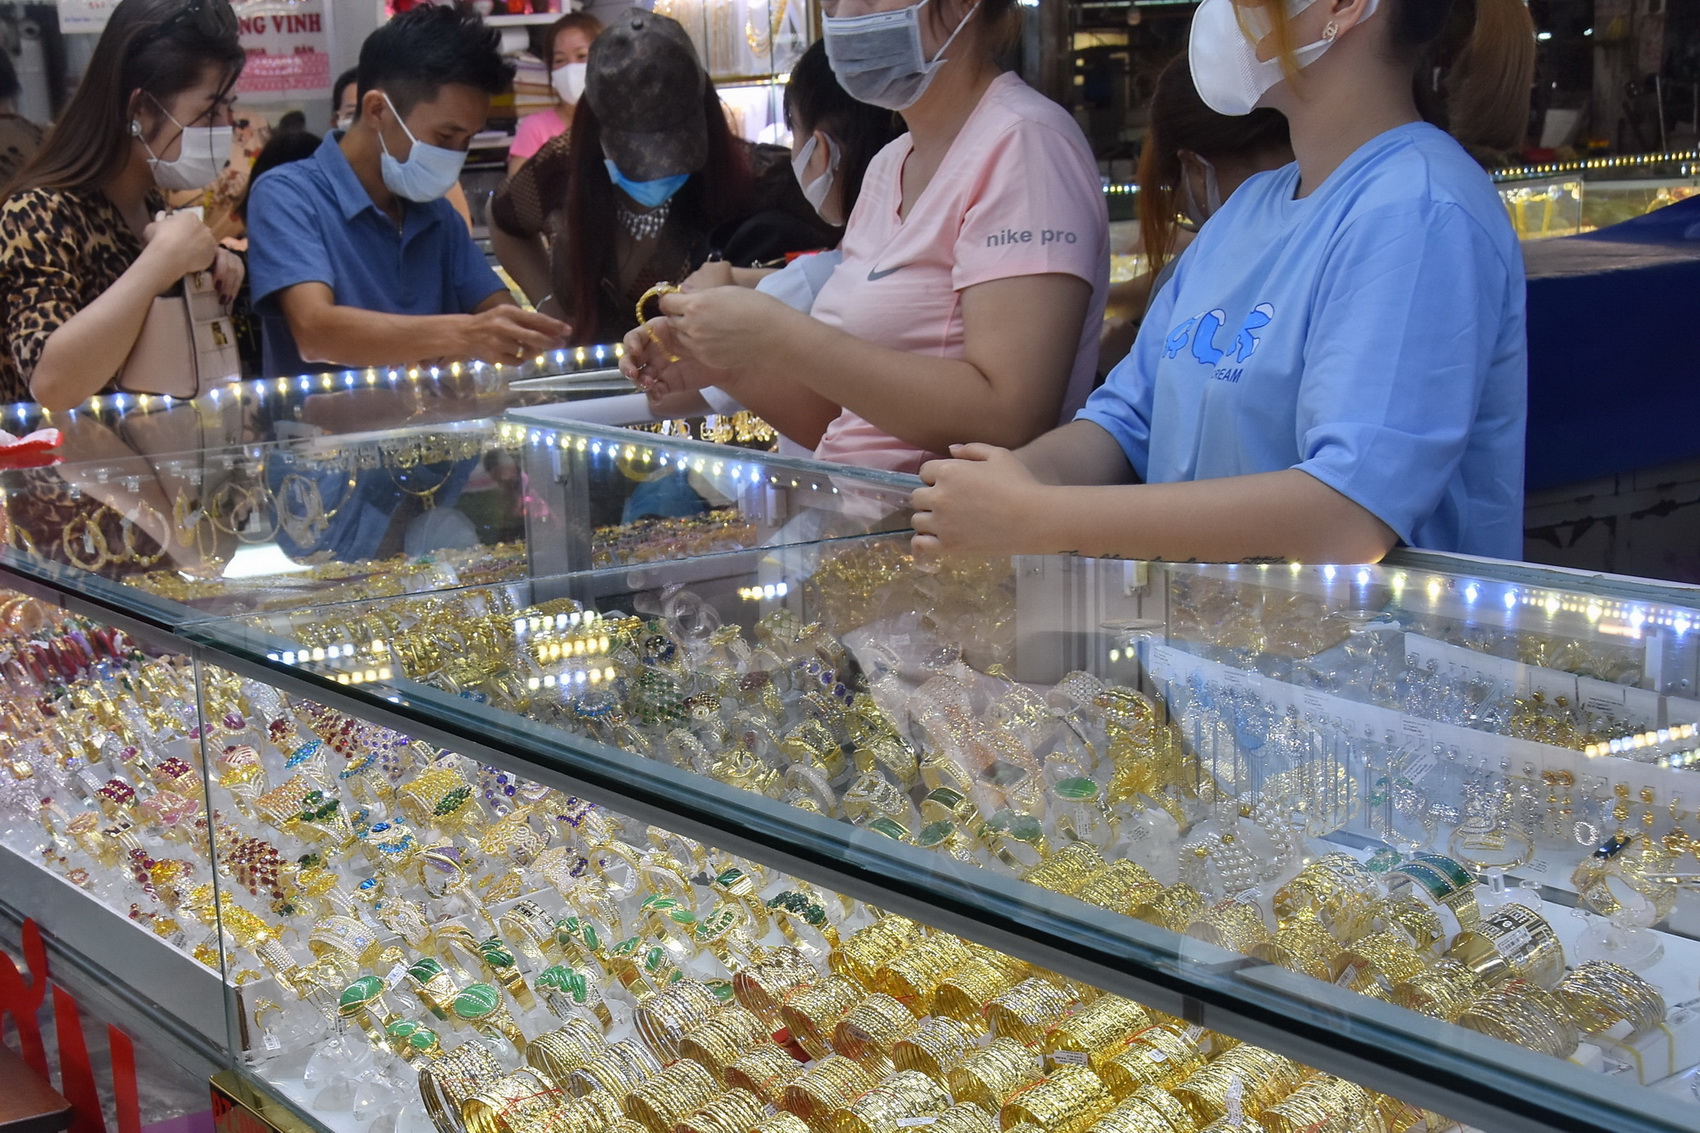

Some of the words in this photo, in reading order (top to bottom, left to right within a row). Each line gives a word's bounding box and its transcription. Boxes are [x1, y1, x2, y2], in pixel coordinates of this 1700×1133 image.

[237, 15, 266, 35] NG
[271, 13, 322, 33] VINH
[987, 229, 1032, 247] nike
[1041, 229, 1077, 245] pro
